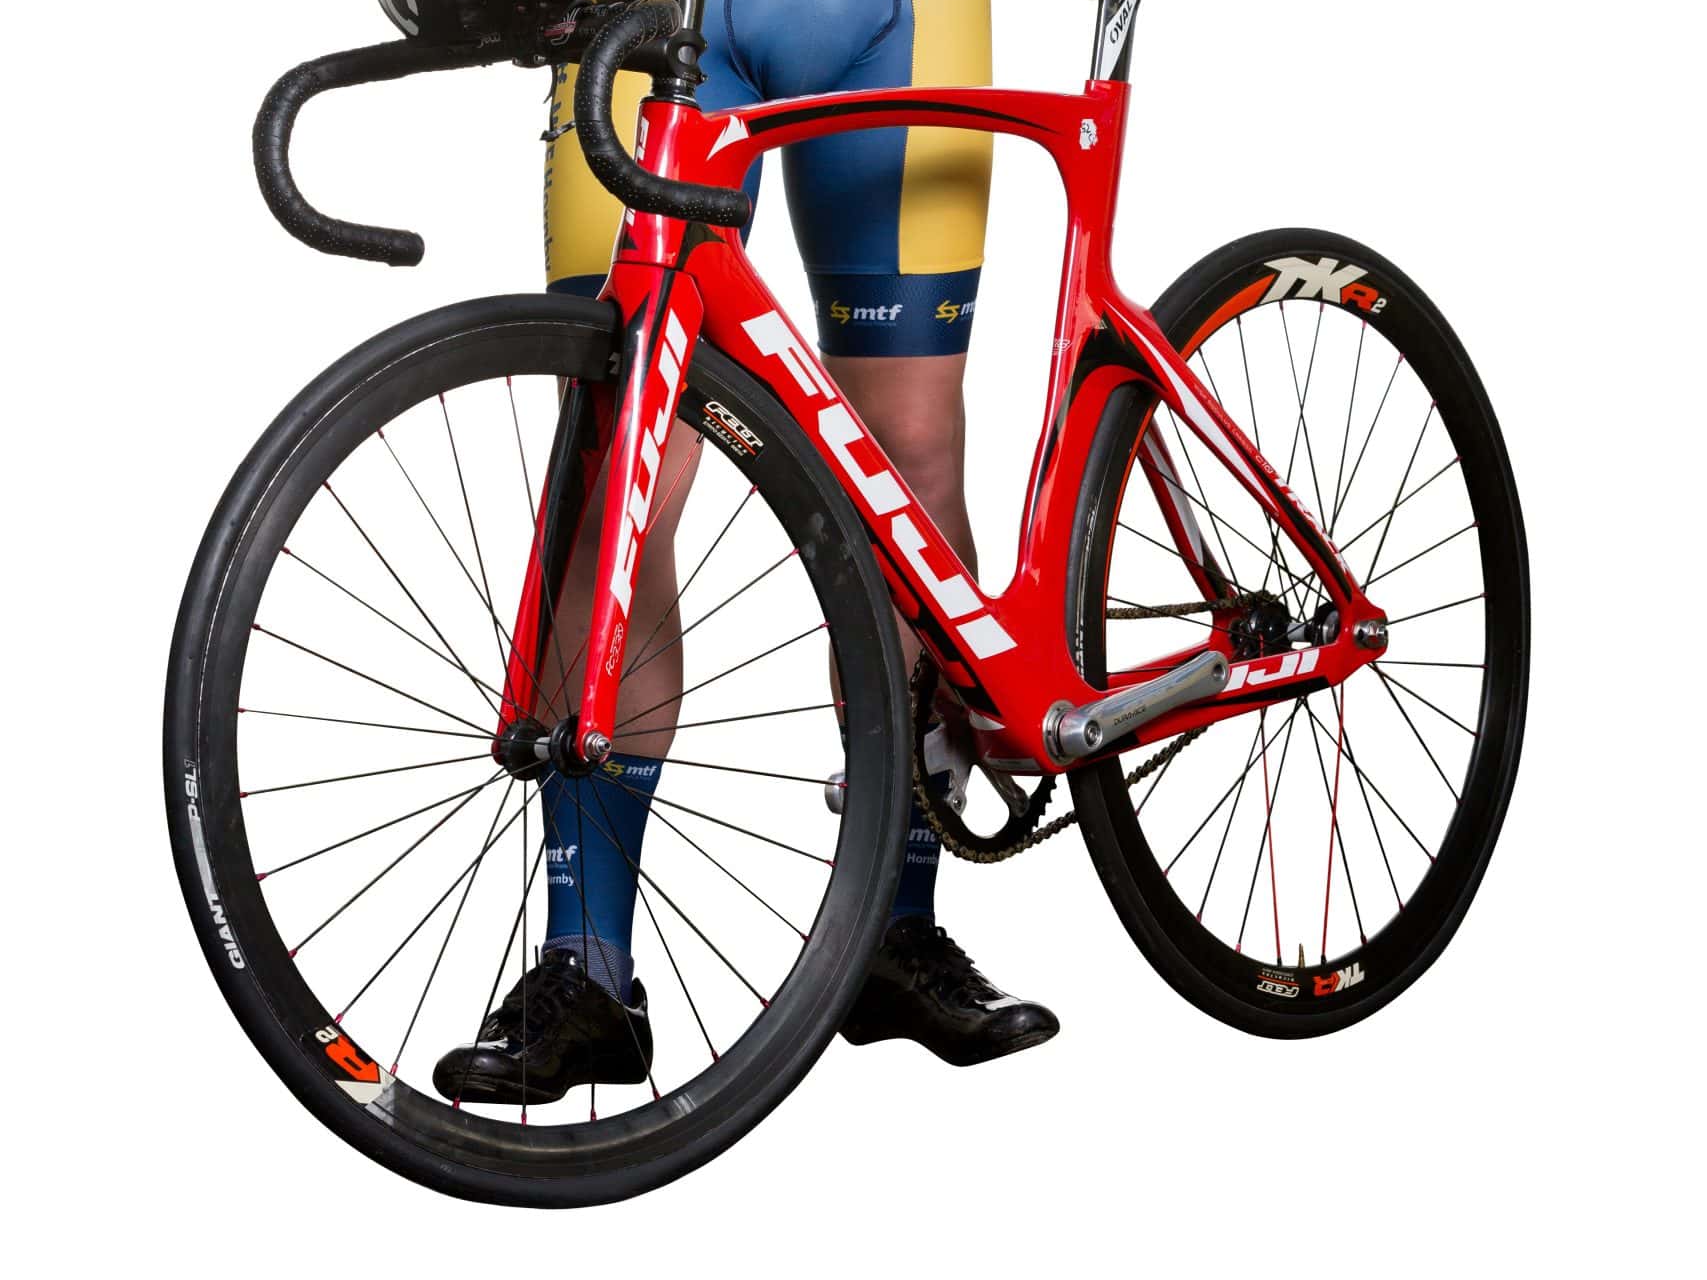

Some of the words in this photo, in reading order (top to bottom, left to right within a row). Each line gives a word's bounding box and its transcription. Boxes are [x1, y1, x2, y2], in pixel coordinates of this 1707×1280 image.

[1110, 1, 1133, 44] OVAL
[853, 305, 903, 320] mtf
[705, 401, 764, 447] FELT
[610, 308, 688, 619] FUJI
[741, 310, 1018, 659] FUJI
[626, 765, 657, 776] mtf
[210, 894, 245, 969] GIANT
